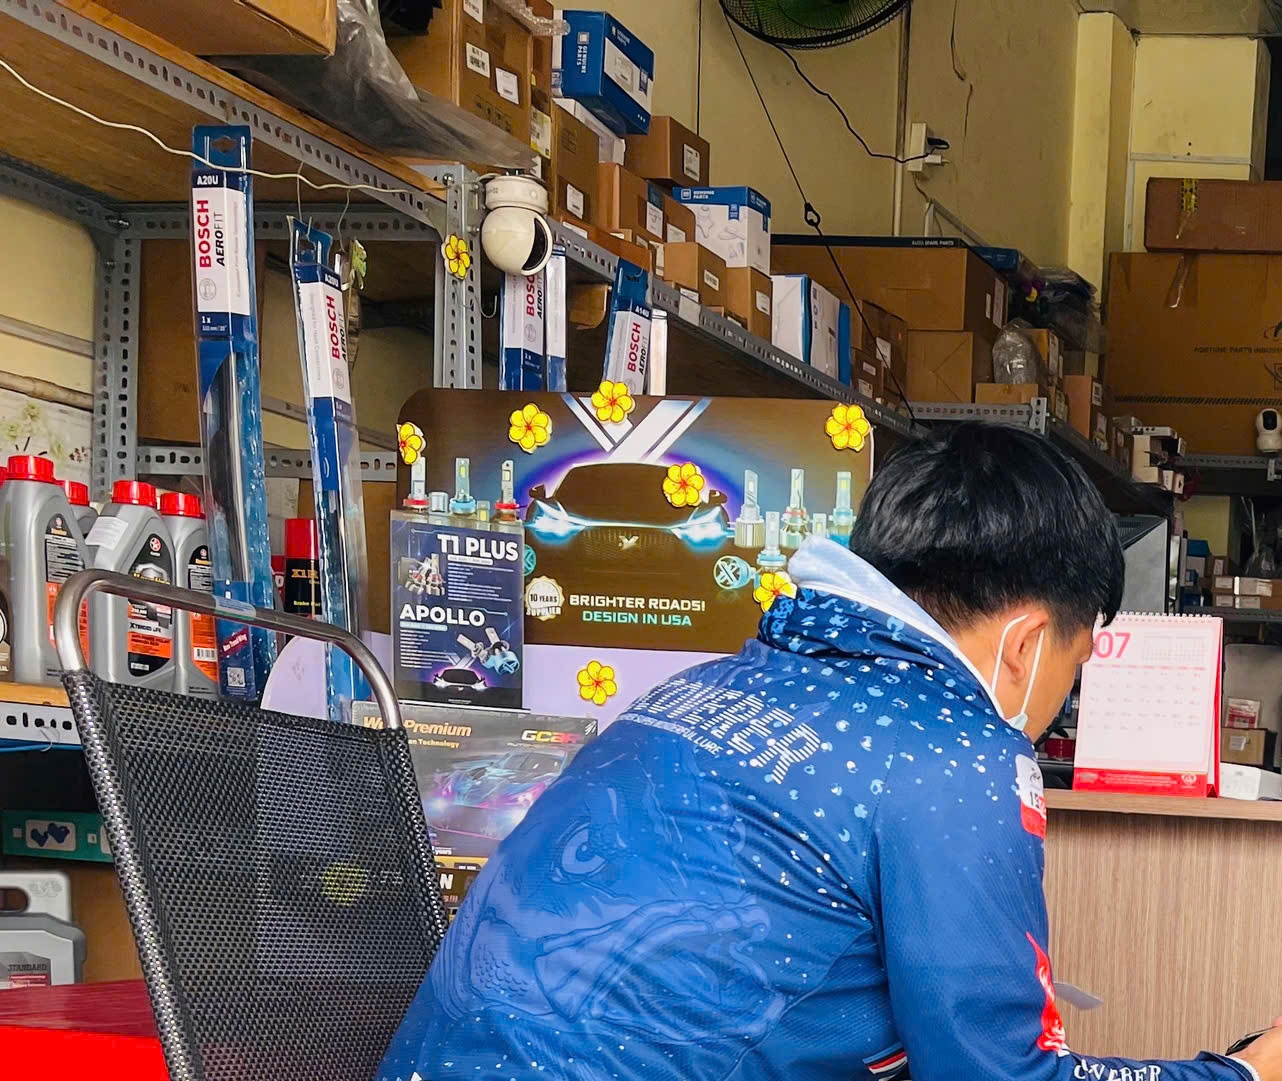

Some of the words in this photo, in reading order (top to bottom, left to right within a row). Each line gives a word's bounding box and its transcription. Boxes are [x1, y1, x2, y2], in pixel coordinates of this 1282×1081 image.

[196, 175, 219, 186] A20U
[196, 199, 212, 269] BOSCH
[215, 211, 225, 267] AEROFIT
[326, 295, 340, 360] BOSCH
[627, 322, 641, 373] BOSCH
[639, 335, 648, 376] AEROFIT
[466, 537, 519, 562] PLUS
[530, 593, 538, 603] 10
[569, 595, 645, 609] BRIGHTER
[649, 598, 706, 612] ROADS!
[400, 603, 486, 627] APOLLO
[582, 610, 639, 624] DESIGN
[643, 614, 658, 625] IN
[661, 614, 692, 626] USA
[1095, 631, 1131, 659] 07
[404, 719, 472, 737] Premium
[417, 738, 460, 749] Technology
[8, 963, 48, 972] STANDARD
